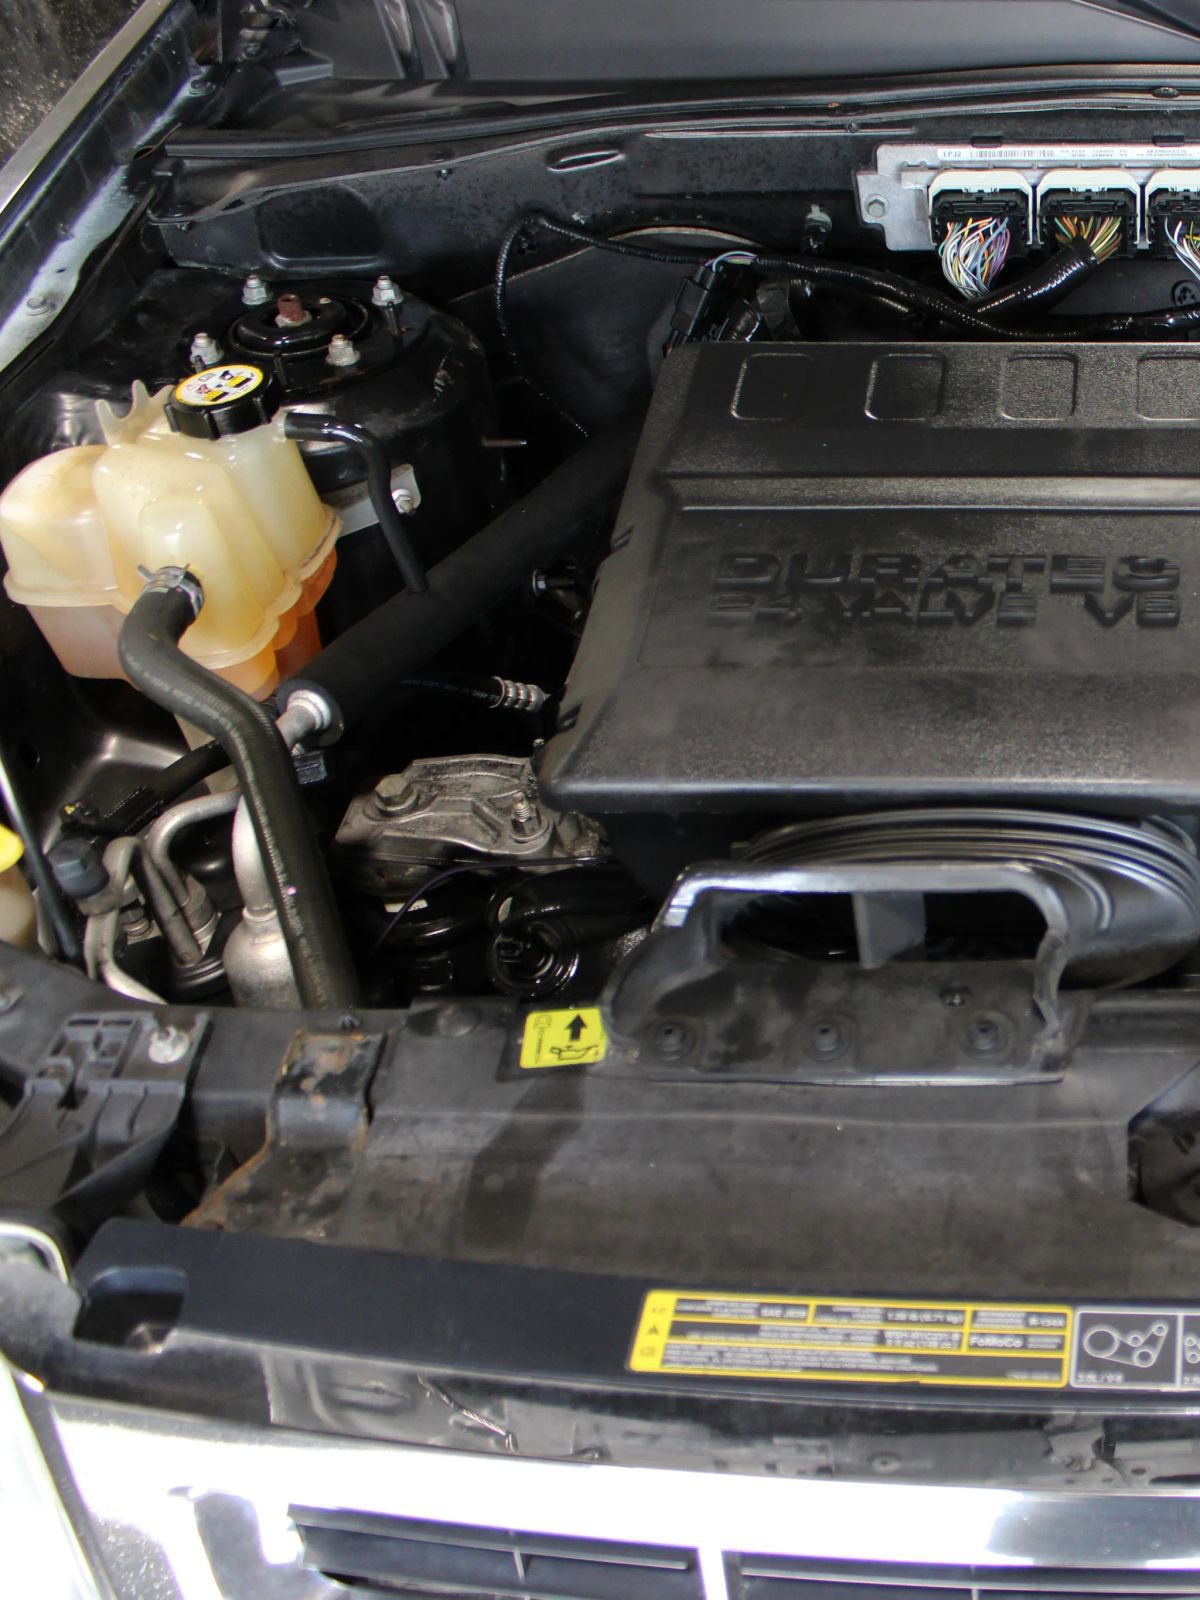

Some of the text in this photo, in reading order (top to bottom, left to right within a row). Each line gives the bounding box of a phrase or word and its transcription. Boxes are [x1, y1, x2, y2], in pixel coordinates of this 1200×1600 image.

[714, 552, 1181, 592] DURATEC
[832, 591, 1037, 627] VALVE
[1084, 592, 1181, 628] V6
[969, 1336, 1023, 1348] FoMoCo
